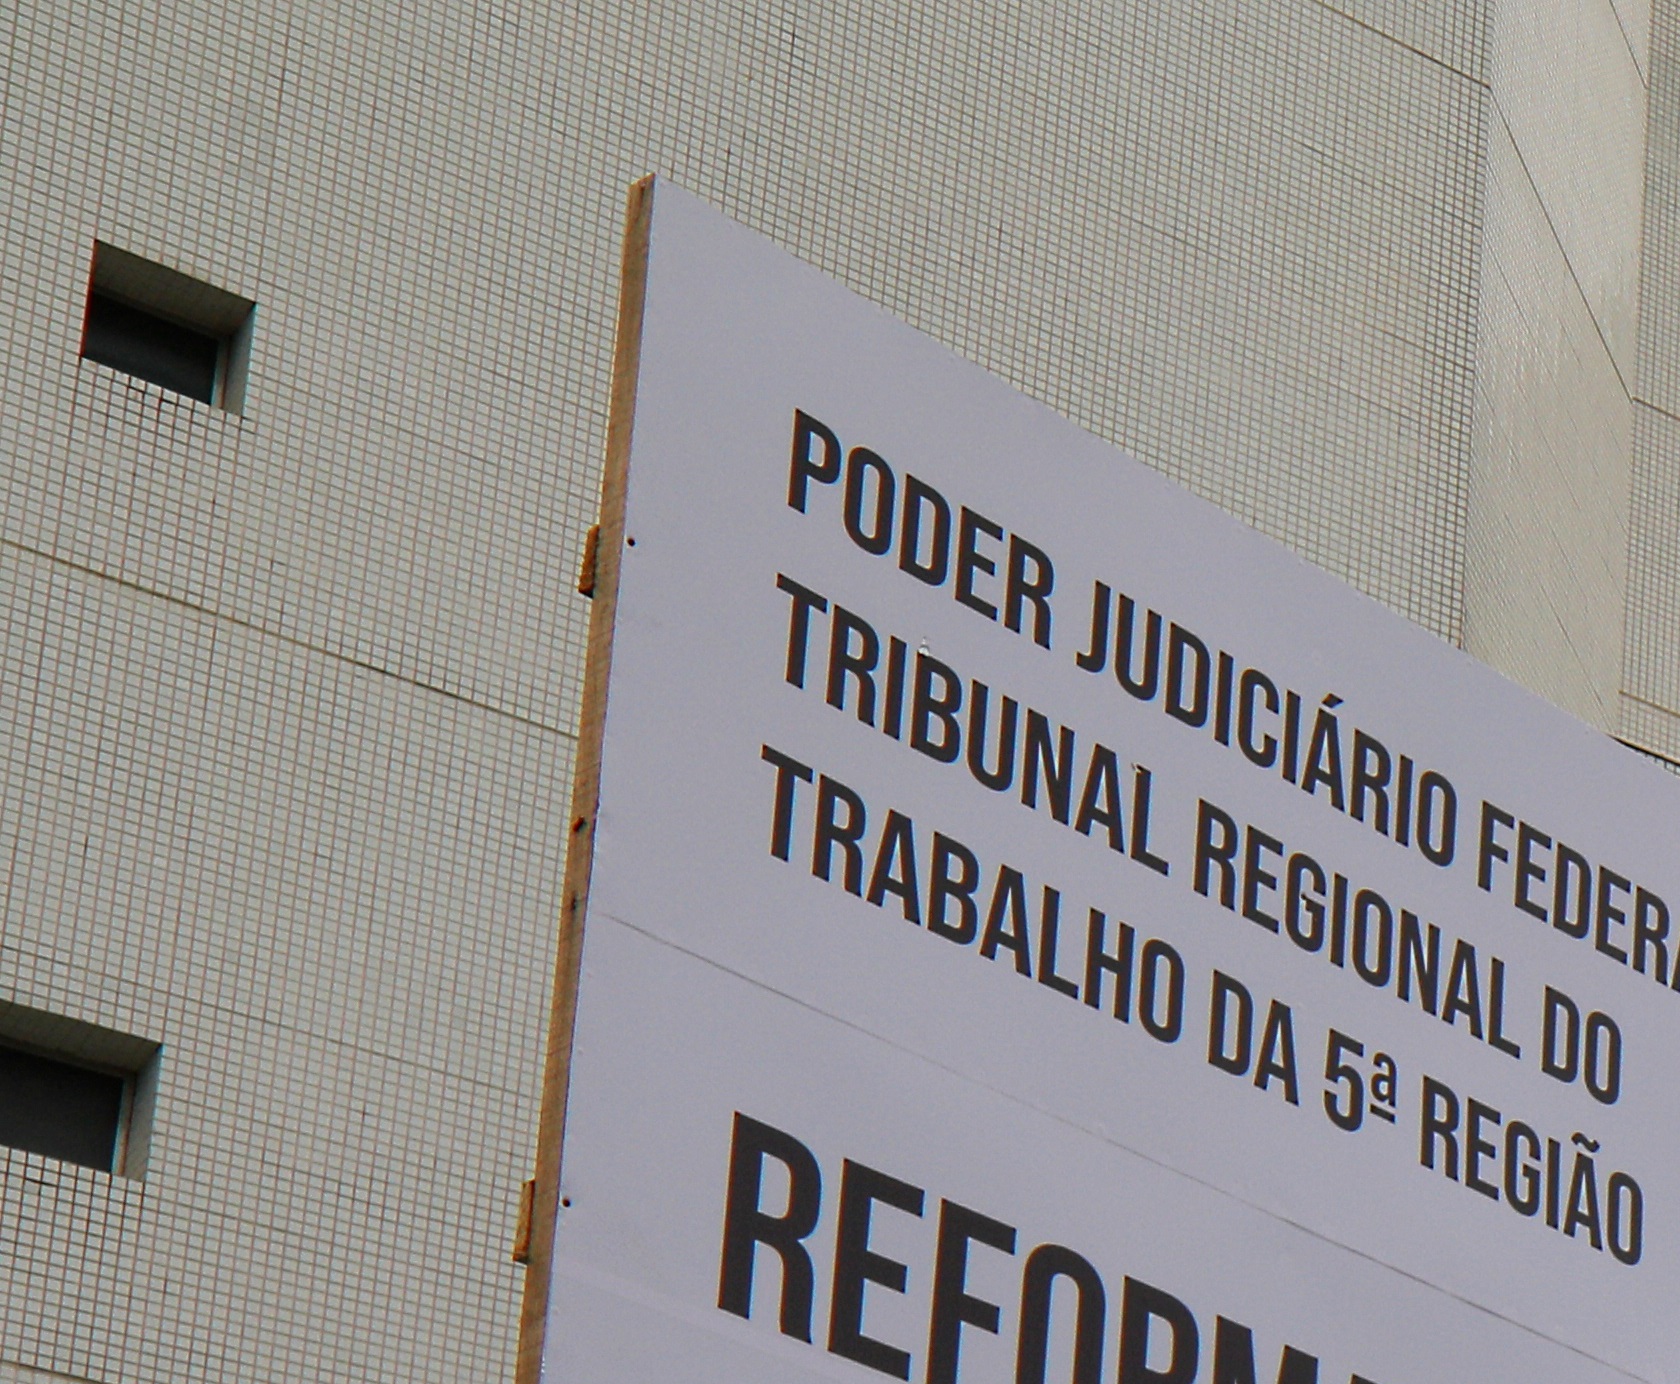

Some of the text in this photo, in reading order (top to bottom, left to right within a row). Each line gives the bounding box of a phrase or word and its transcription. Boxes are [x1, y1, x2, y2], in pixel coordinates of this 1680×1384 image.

[776, 573, 1622, 1106] TRIBUNAL REGIONAL DO
[788, 408, 1054, 649] PODER
[1077, 580, 1457, 869] JUDICIÁRIO
[761, 744, 1644, 1267] TRABALHO DA 5ª REGIÃO
